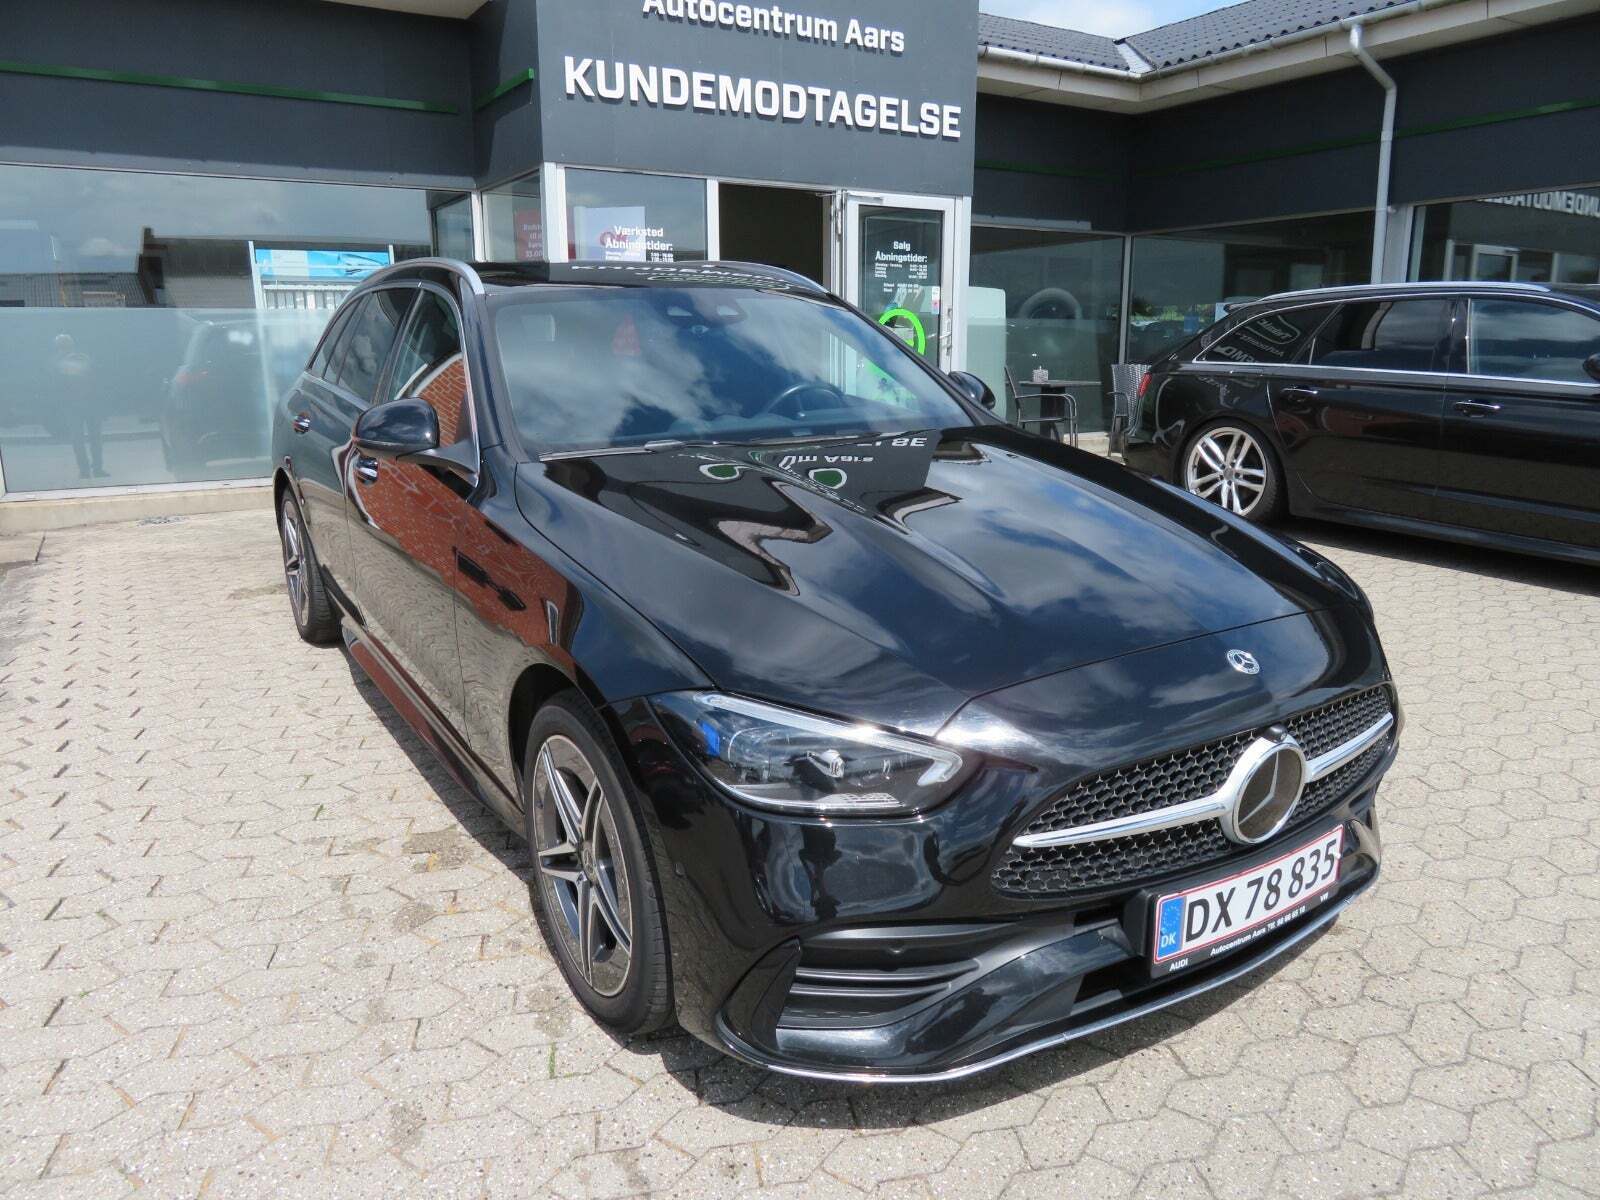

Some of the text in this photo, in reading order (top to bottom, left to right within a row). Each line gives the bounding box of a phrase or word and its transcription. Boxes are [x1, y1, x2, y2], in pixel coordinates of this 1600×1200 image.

[844, 19, 905, 53] Aars
[564, 56, 961, 138] KUNDEMODTAGELSE
[613, 226, 664, 238] Værksted
[893, 240, 911, 252] Salg
[1185, 838, 1337, 942] DX 78 835
[1161, 932, 1176, 948] DK
[1210, 934, 1251, 956] Autocentrum
[1169, 958, 1189, 972] AUDI
